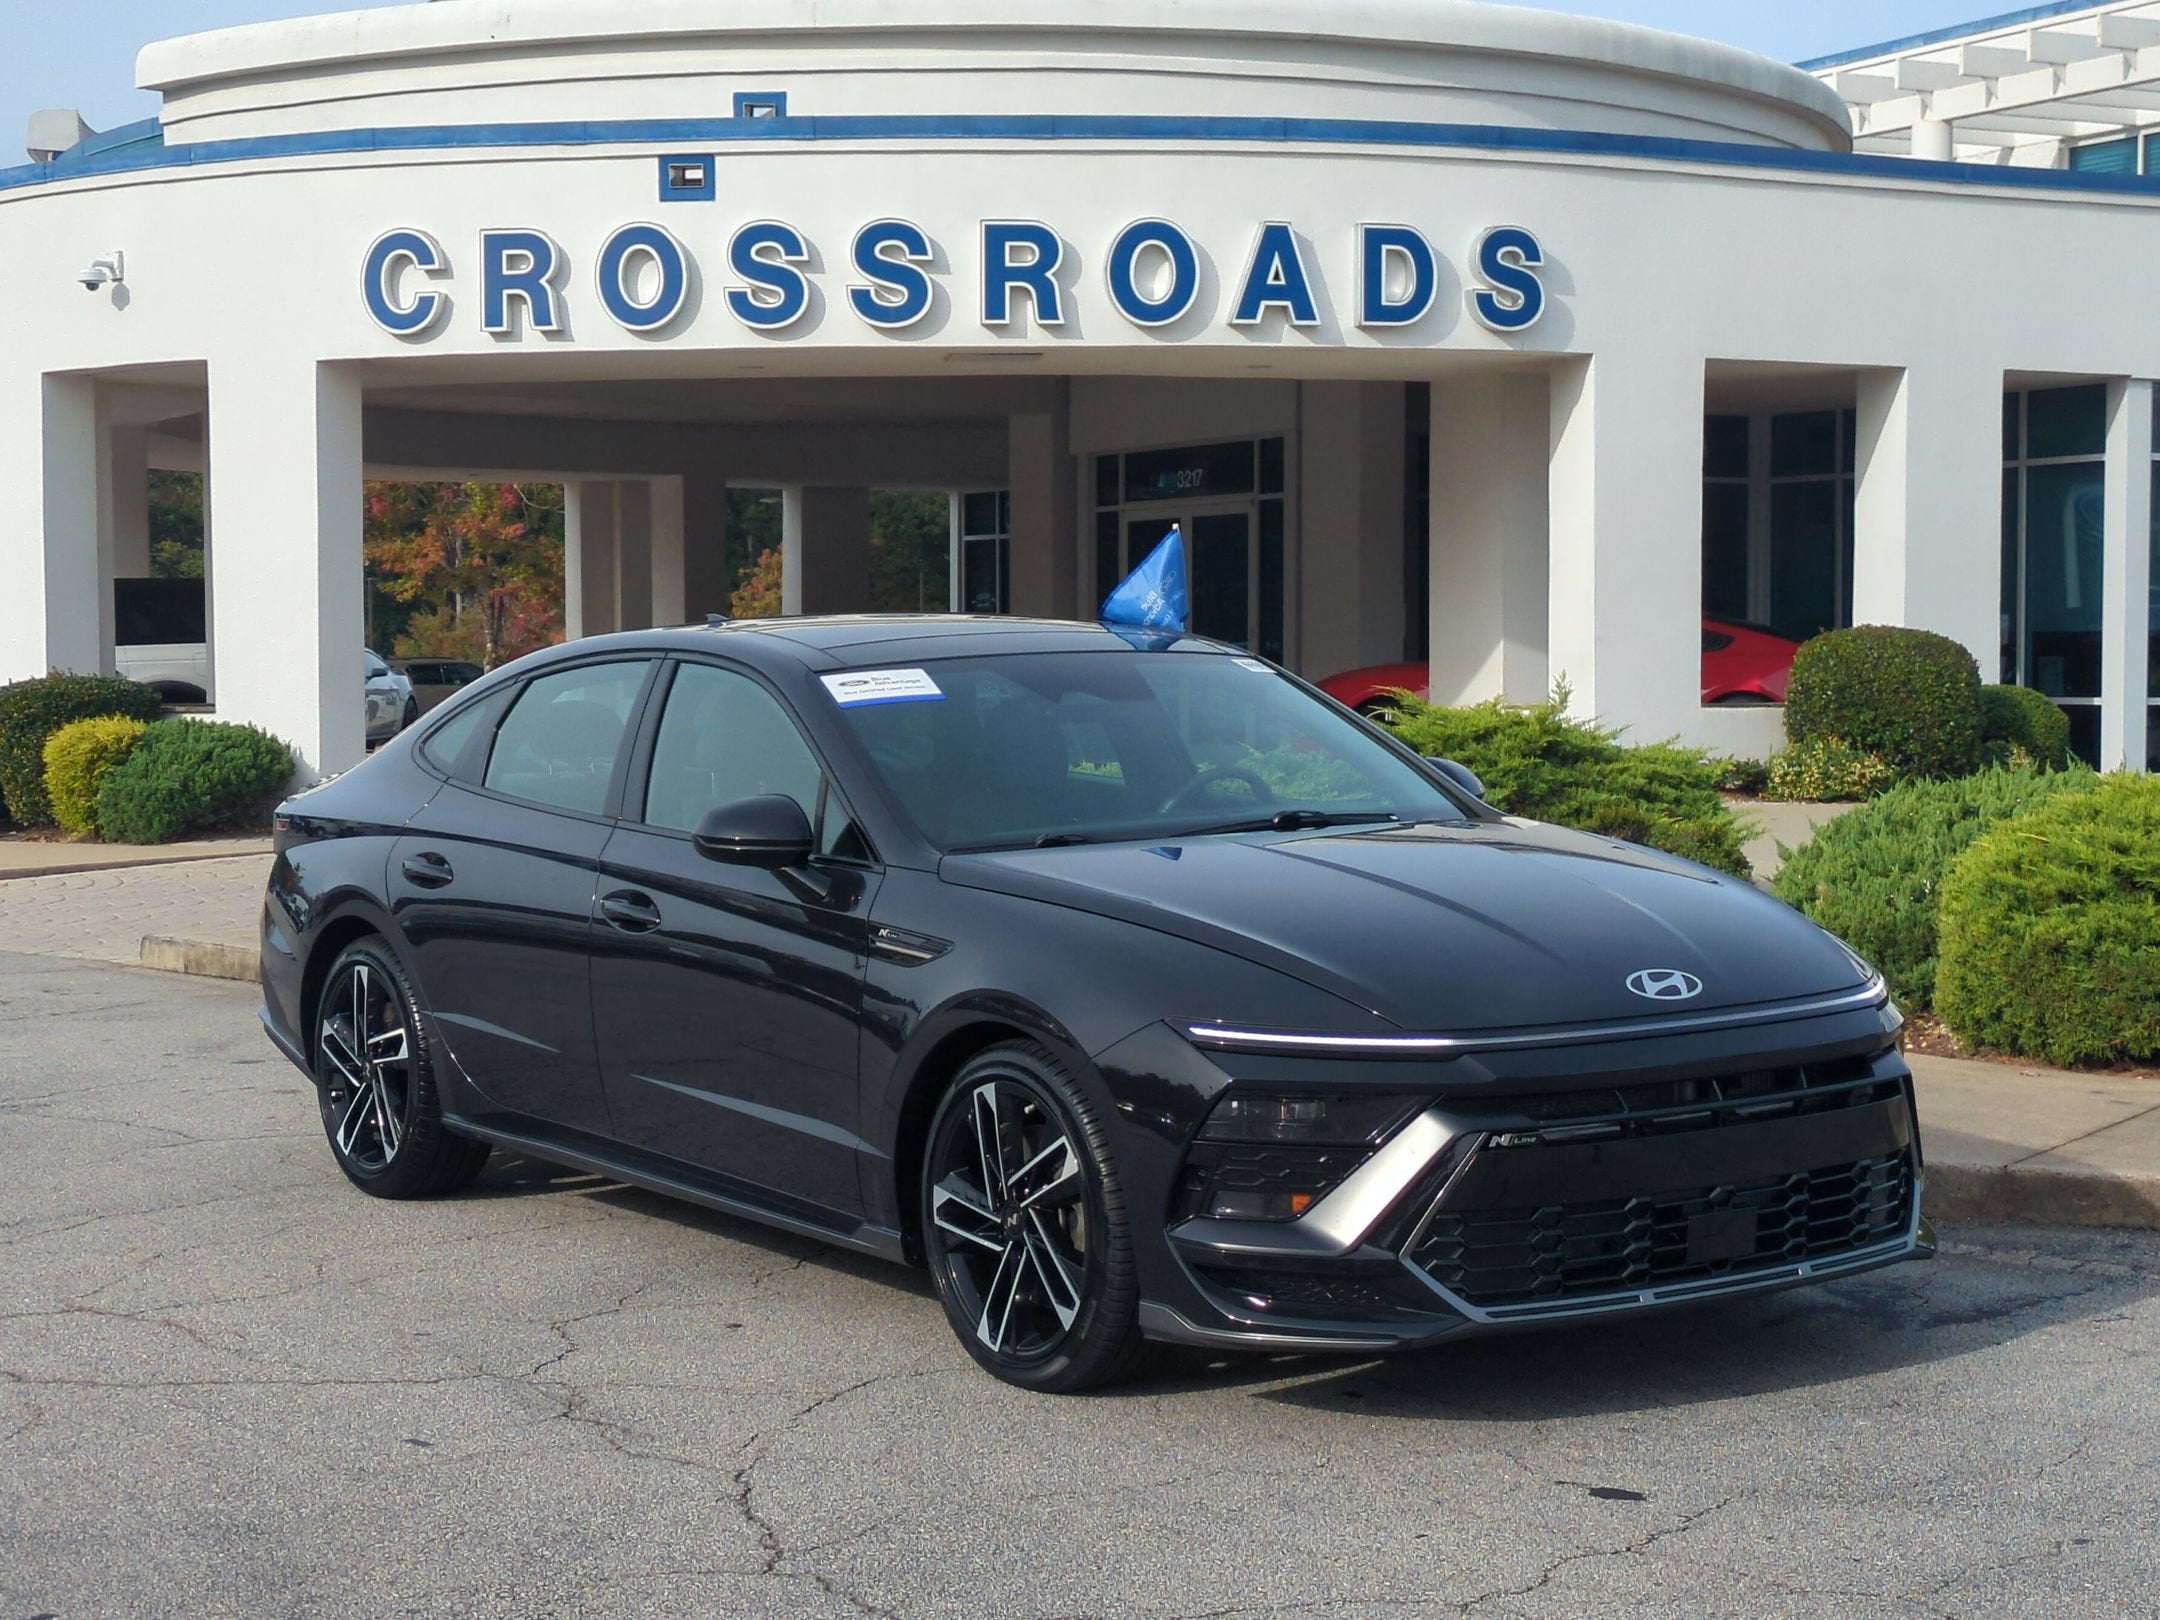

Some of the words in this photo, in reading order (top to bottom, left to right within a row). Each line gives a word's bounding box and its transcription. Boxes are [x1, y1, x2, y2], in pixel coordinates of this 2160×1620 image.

[360, 217, 1545, 336] CROSSROADS
[1177, 469, 1203, 488] 3217
[878, 928, 890, 937] N
[1489, 1133, 1512, 1148] N
[1514, 1136, 1537, 1144] Line
